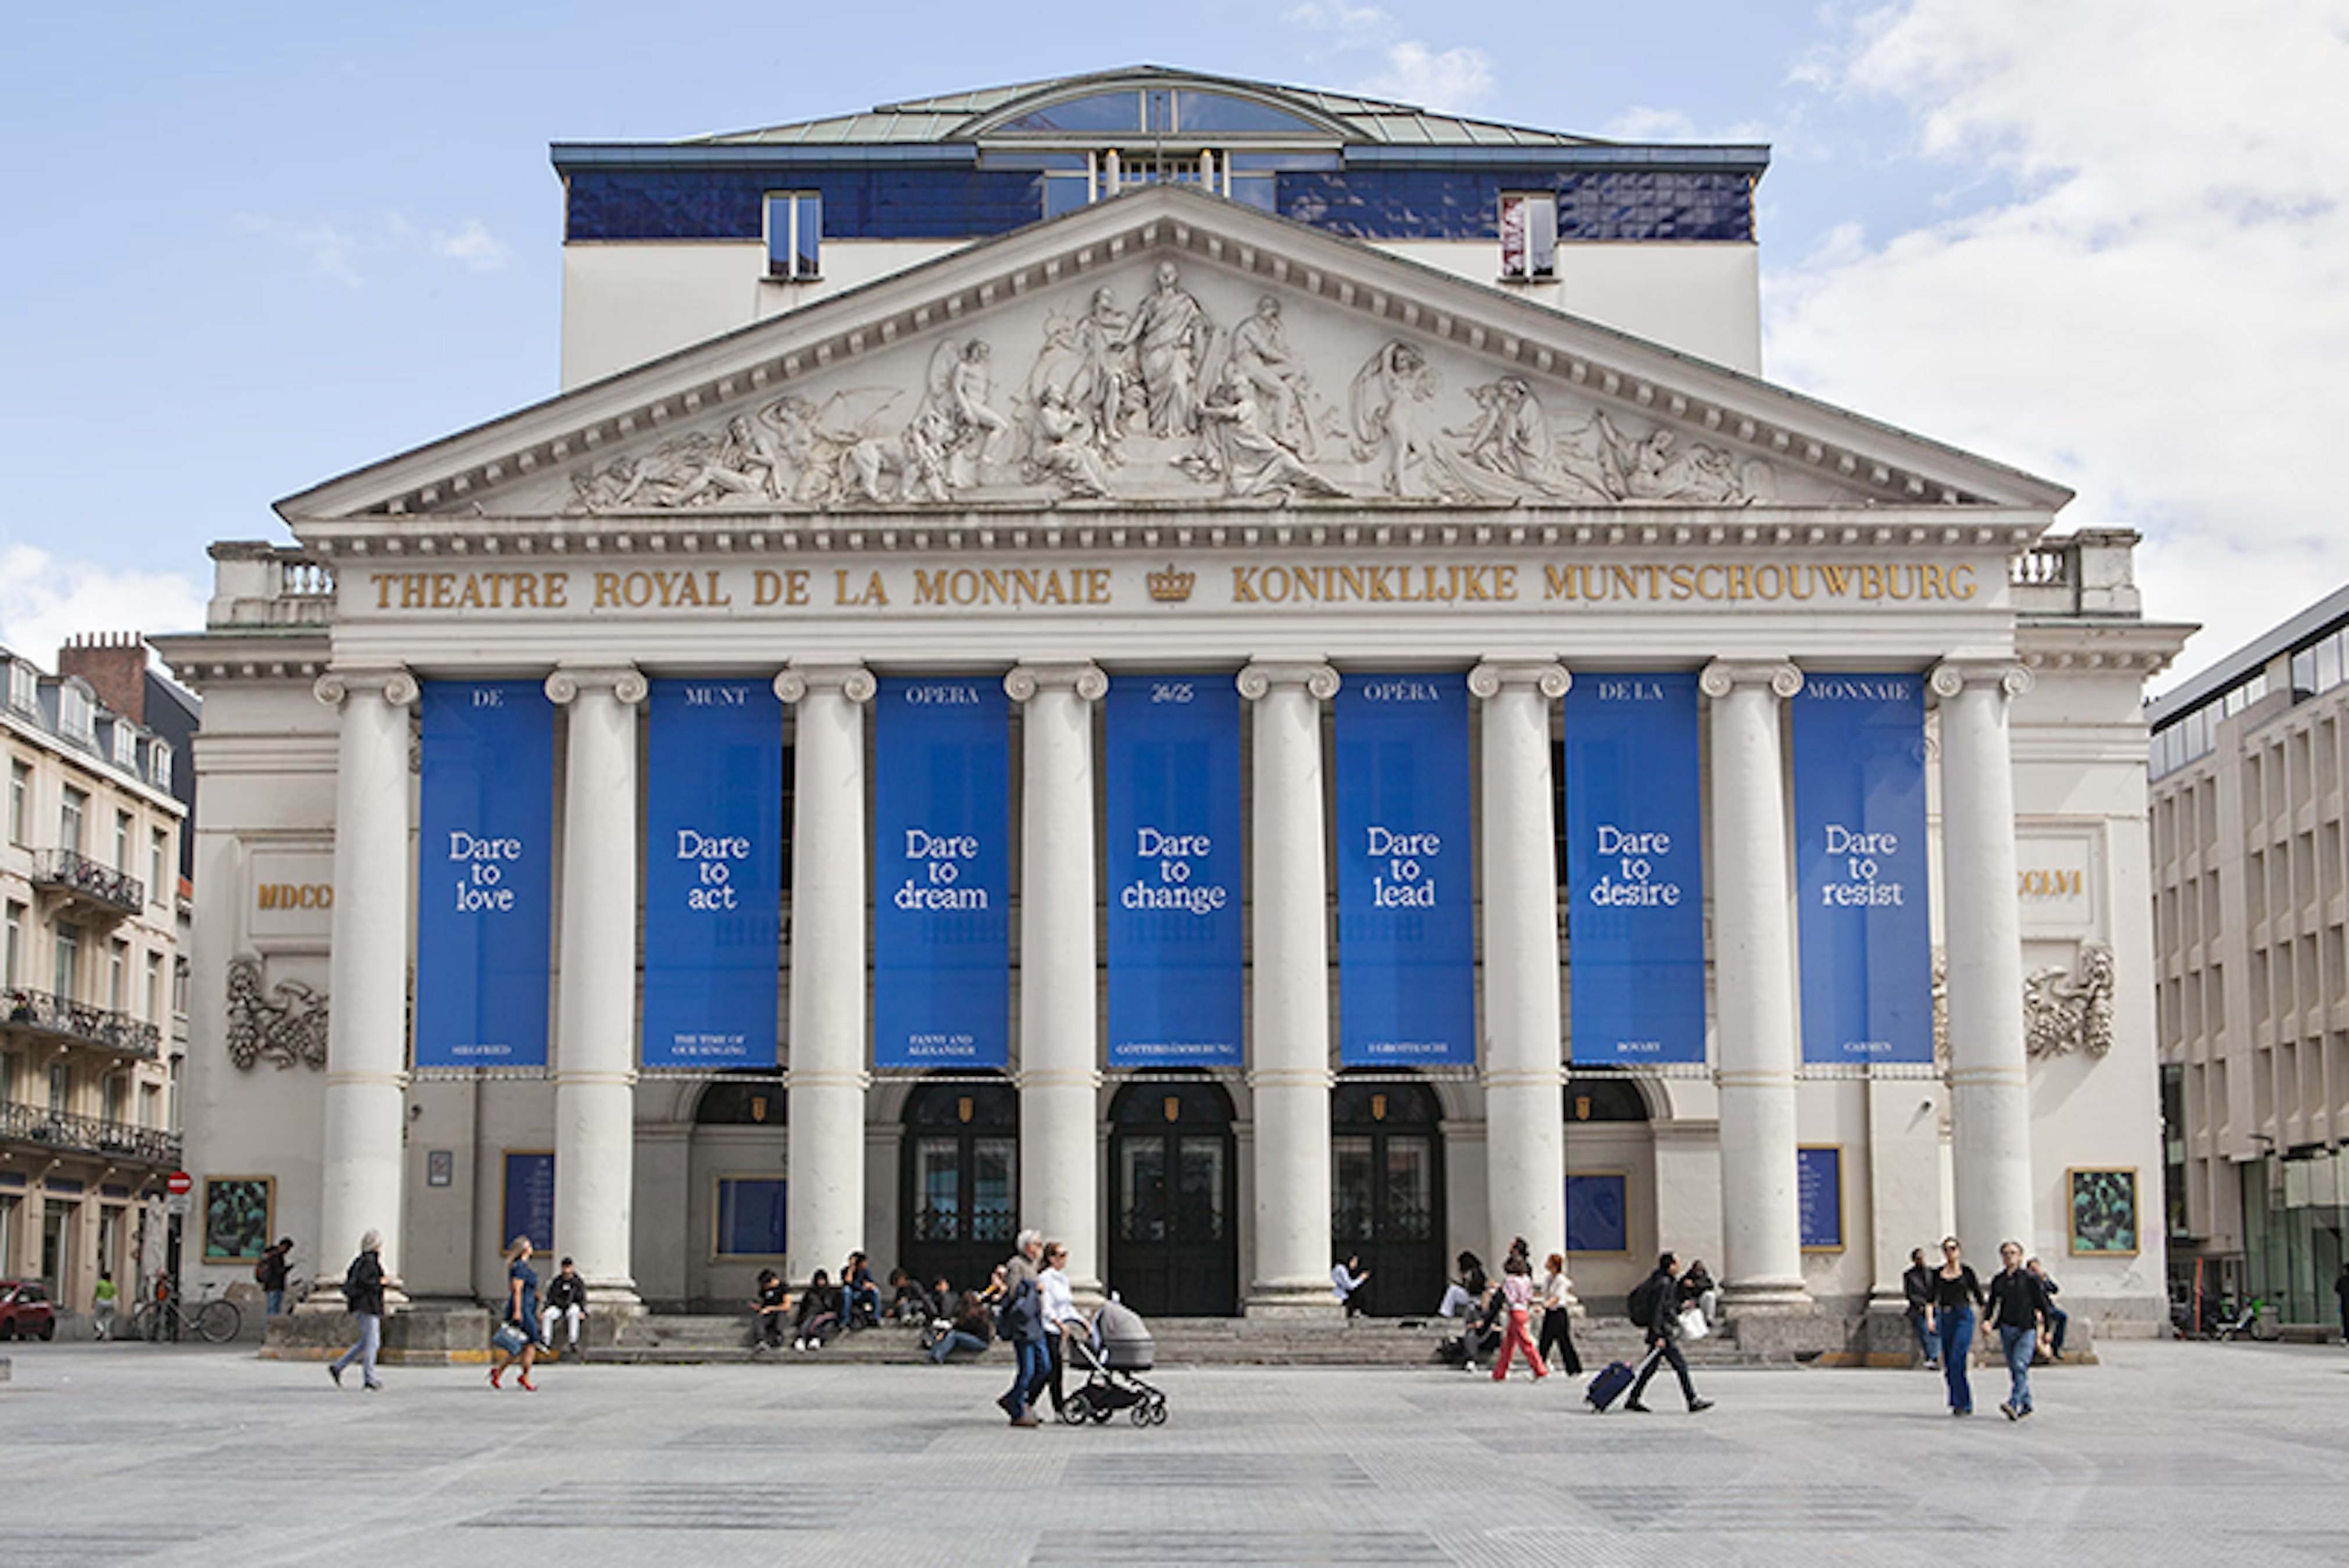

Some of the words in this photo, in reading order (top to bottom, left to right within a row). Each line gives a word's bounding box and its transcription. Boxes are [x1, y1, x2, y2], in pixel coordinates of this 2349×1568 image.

[371, 572, 568, 608] THEATRE
[595, 571, 731, 607] ROYAL
[755, 570, 810, 605] DE
[837, 570, 888, 605] LA
[915, 569, 1111, 605] MONNAIE
[1234, 565, 1518, 602] KONINKLIJKE
[1545, 563, 1977, 600] MUNTSCHOUWBURG
[473, 690, 503, 706] DE
[686, 688, 748, 705] MUNT
[906, 687, 980, 703] OPERA
[1363, 681, 1438, 701] OPÉRA
[1599, 683, 1630, 700] DE
[1634, 683, 1663, 699] LA
[1808, 682, 1909, 700] MONNAIE
[449, 831, 521, 860] Dare
[677, 830, 750, 859] Dare
[906, 830, 979, 859] Dare
[1138, 827, 1211, 857] Dare
[1367, 827, 1440, 856] Dare
[1598, 826, 1670, 855] Dare
[1826, 825, 1898, 855] Dare
[472, 863, 501, 884] to
[699, 861, 730, 884] to
[929, 861, 959, 883] to
[1161, 859, 1191, 882] to
[1390, 858, 1420, 881] to
[1621, 857, 1652, 880] to
[1848, 856, 1879, 879] to
[456, 882, 514, 912] love
[688, 885, 737, 910] act
[894, 880, 988, 910] dream
[1121, 878, 1226, 915] change
[1373, 877, 1436, 908] lead
[1590, 876, 1680, 906] desire
[1822, 876, 1904, 906] resist
